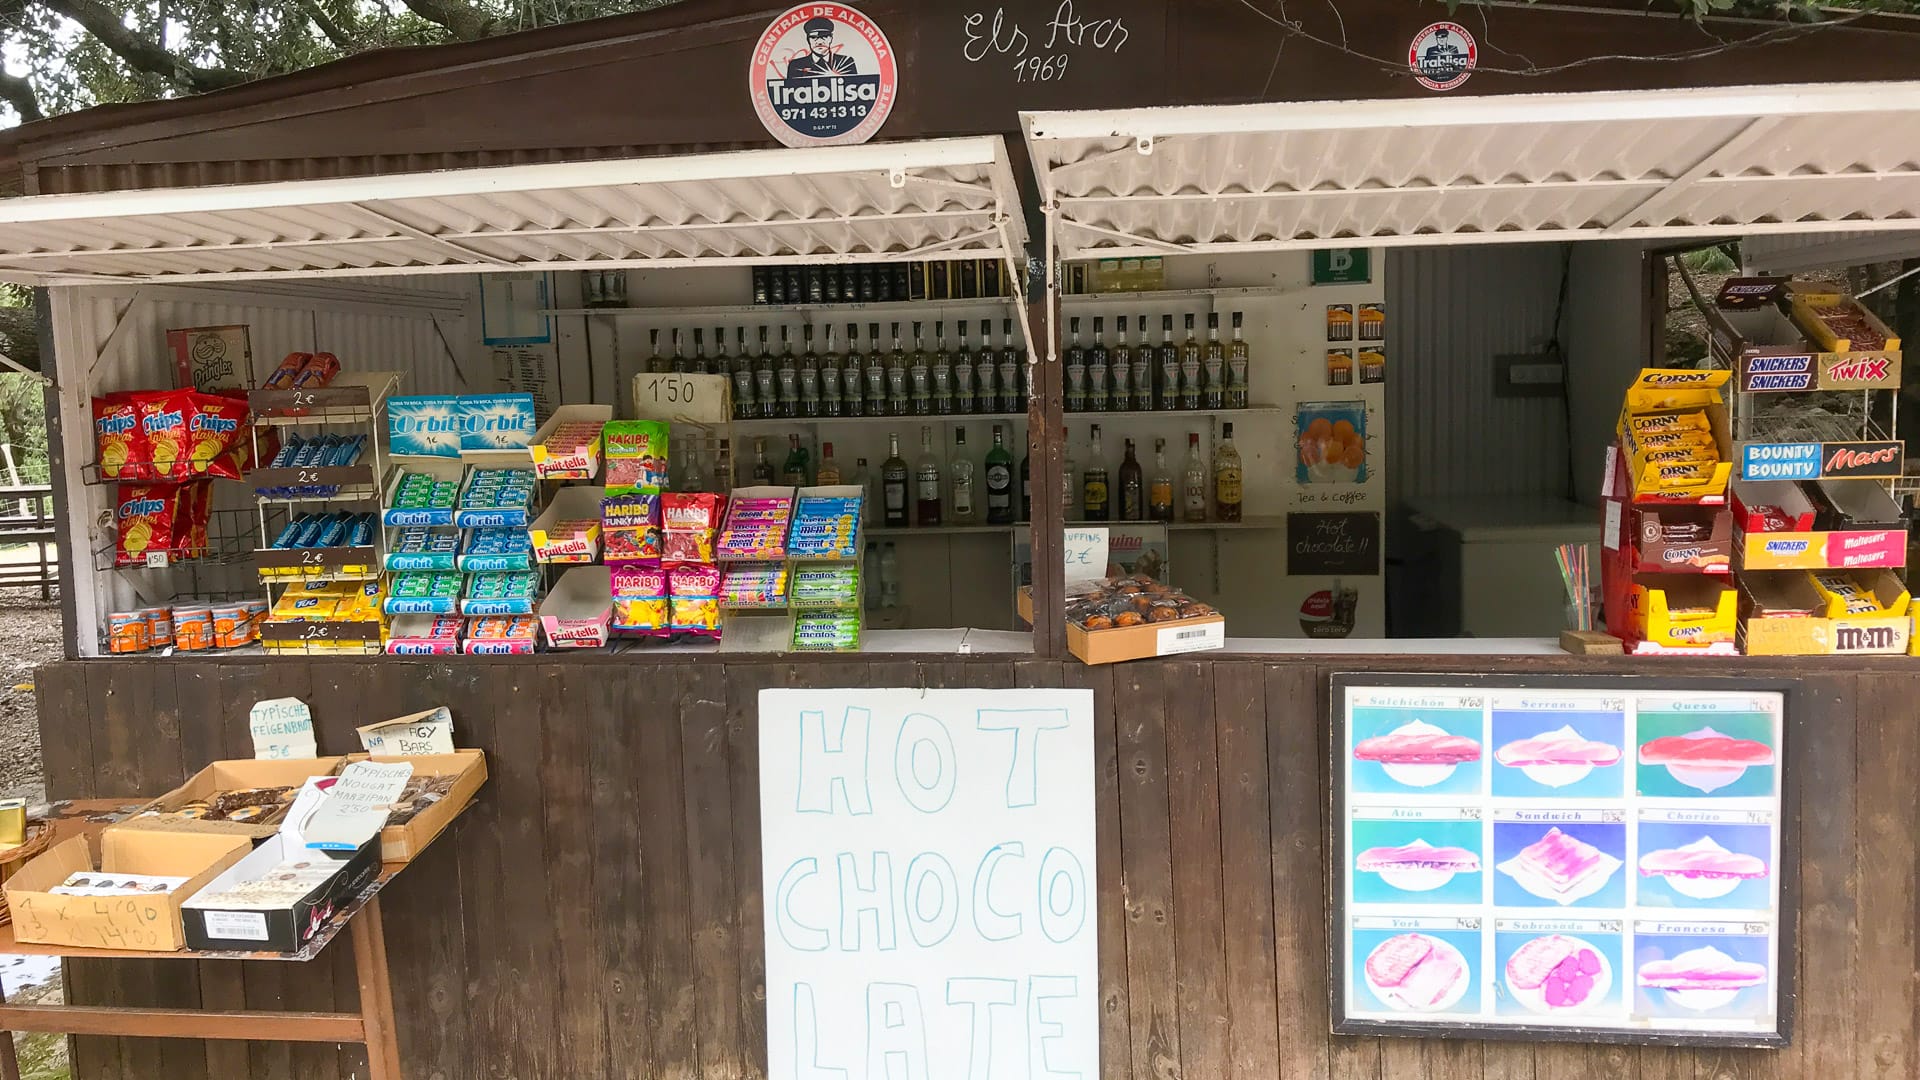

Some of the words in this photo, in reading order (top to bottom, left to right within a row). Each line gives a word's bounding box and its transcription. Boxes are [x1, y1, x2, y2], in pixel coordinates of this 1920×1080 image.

[757, 10, 810, 66] CENTRAL
[813, 7, 834, 17] DE
[838, 10, 888, 60] ALARMA
[964, 7, 1028, 62] Els
[1418, 56, 1467, 68] Trablisa
[768, 78, 876, 106] Trablisa
[782, 108, 806, 120] 971
[810, 108, 828, 119] 43
[830, 106, 848, 118] 13
[850, 106, 868, 117] 13
[1748, 356, 1811, 372] SNICKERS
[194, 360, 233, 387] Pringles
[1748, 373, 1812, 390] SNICKERS
[96, 414, 136, 434] Chips
[142, 410, 183, 434] Chips
[190, 414, 237, 432] Chips
[395, 414, 456, 434] Orbit
[466, 412, 527, 432] Orbit
[1634, 415, 1680, 430] CORNY
[608, 434, 650, 444] HARIBO
[1645, 448, 1692, 463] CORNY
[1749, 446, 1815, 460] BOUNTY
[1826, 448, 1898, 472] Mars
[1659, 465, 1698, 476] ORNY
[1748, 462, 1814, 477] BOUNTY
[1296, 493, 1314, 503] Tea
[119, 496, 164, 518] Chips
[605, 504, 649, 516] HARIBO
[390, 512, 431, 525] Orbit
[464, 514, 504, 526] Orbit
[606, 516, 632, 526] FUNKY
[633, 516, 649, 524] MIX
[800, 525, 837, 534] mentos
[1316, 519, 1348, 536] Hot
[727, 538, 764, 547] mentos
[798, 539, 834, 547] mentos
[1296, 538, 1354, 554] chocolate
[1766, 540, 1809, 552] SNICKERS
[1844, 533, 1886, 548] Maltesers
[538, 542, 587, 560] Fruit-tella
[1663, 548, 1701, 560] CORNY
[392, 557, 433, 569] Orbit
[468, 558, 508, 570] Orbit
[1844, 551, 1886, 566] Maltesers
[616, 576, 660, 587] HARIBO
[672, 575, 716, 587] HARIBO
[296, 598, 317, 608] TUC
[394, 601, 433, 613] Orbit
[471, 603, 510, 614] Orbit
[549, 626, 599, 642] Fruit-tella
[1669, 626, 1704, 637] CORNY
[395, 644, 434, 655] Orbit
[473, 644, 512, 655] Orbit
[1521, 699, 1576, 709] Serrano
[1672, 701, 1716, 712] Queso
[252, 704, 308, 722] TYPISCHE
[400, 740, 432, 752] BARS
[796, 706, 1070, 816] HOT
[341, 778, 396, 791] NOUGAT
[334, 790, 392, 802] MARZIPAN
[1514, 810, 1582, 820] Sandwich
[1667, 812, 1720, 821] Chorizo
[775, 841, 1086, 952] CHOCO
[1391, 919, 1420, 928] York
[1512, 922, 1583, 931] Sobrasada
[1657, 923, 1726, 933] Francesa
[794, 974, 1082, 1080] LATE
